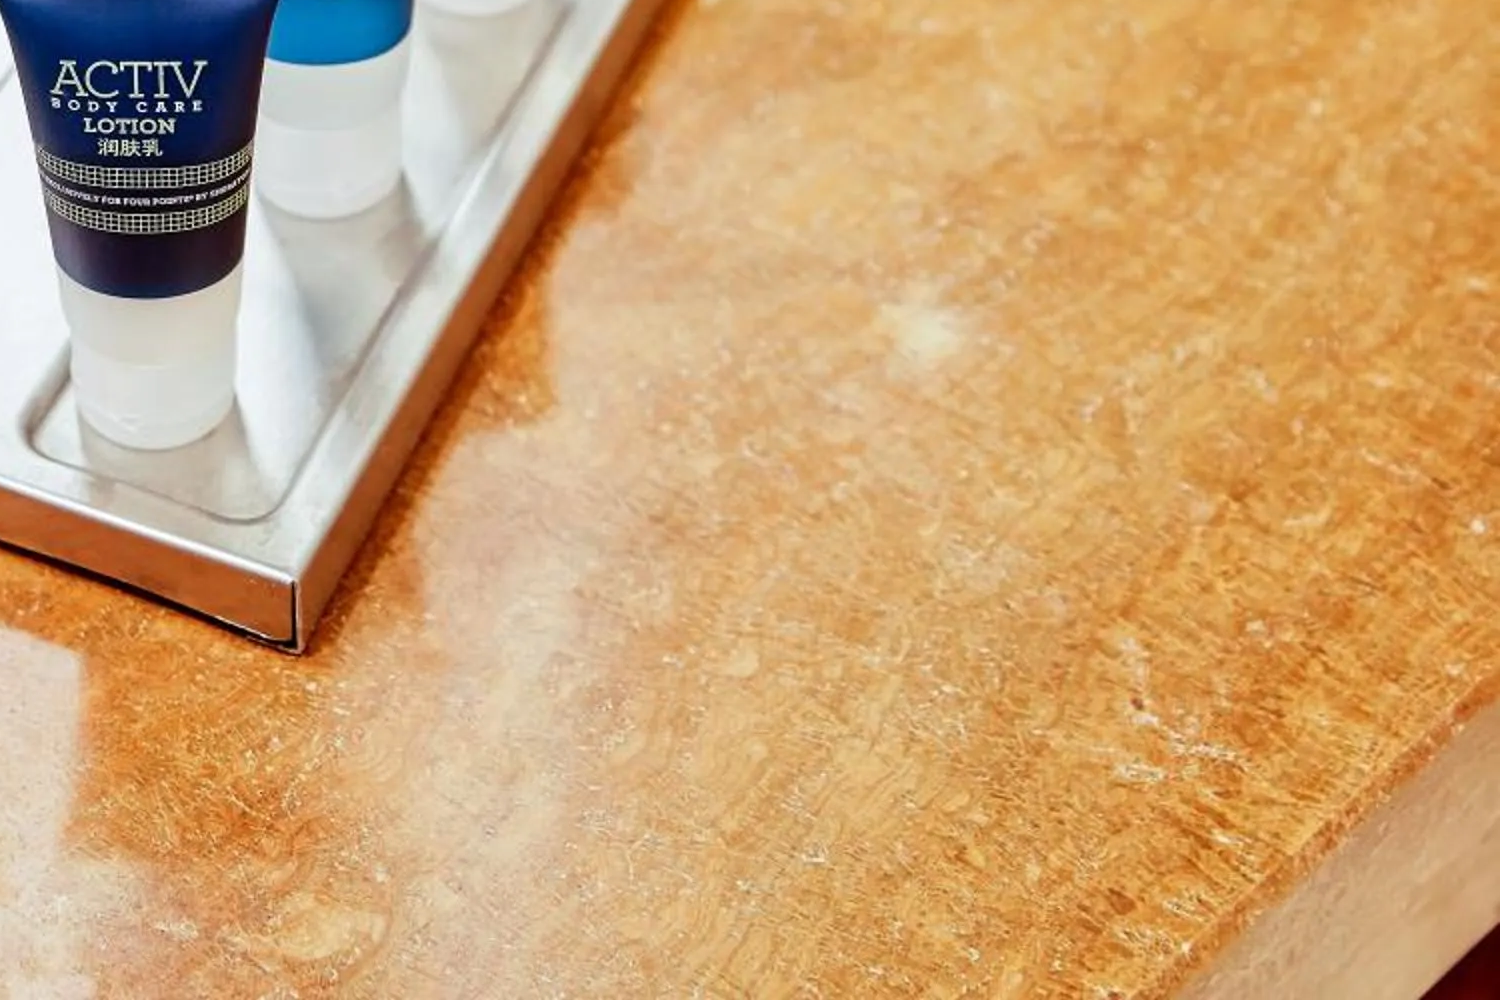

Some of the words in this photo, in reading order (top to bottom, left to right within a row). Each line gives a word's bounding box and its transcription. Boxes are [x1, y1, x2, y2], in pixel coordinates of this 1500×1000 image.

[50, 59, 209, 99] ACTIV
[51, 97, 119, 113] BODY
[135, 100, 203, 113] CARE
[83, 117, 176, 135] LOTION
[97, 138, 164, 157] 润肤乳
